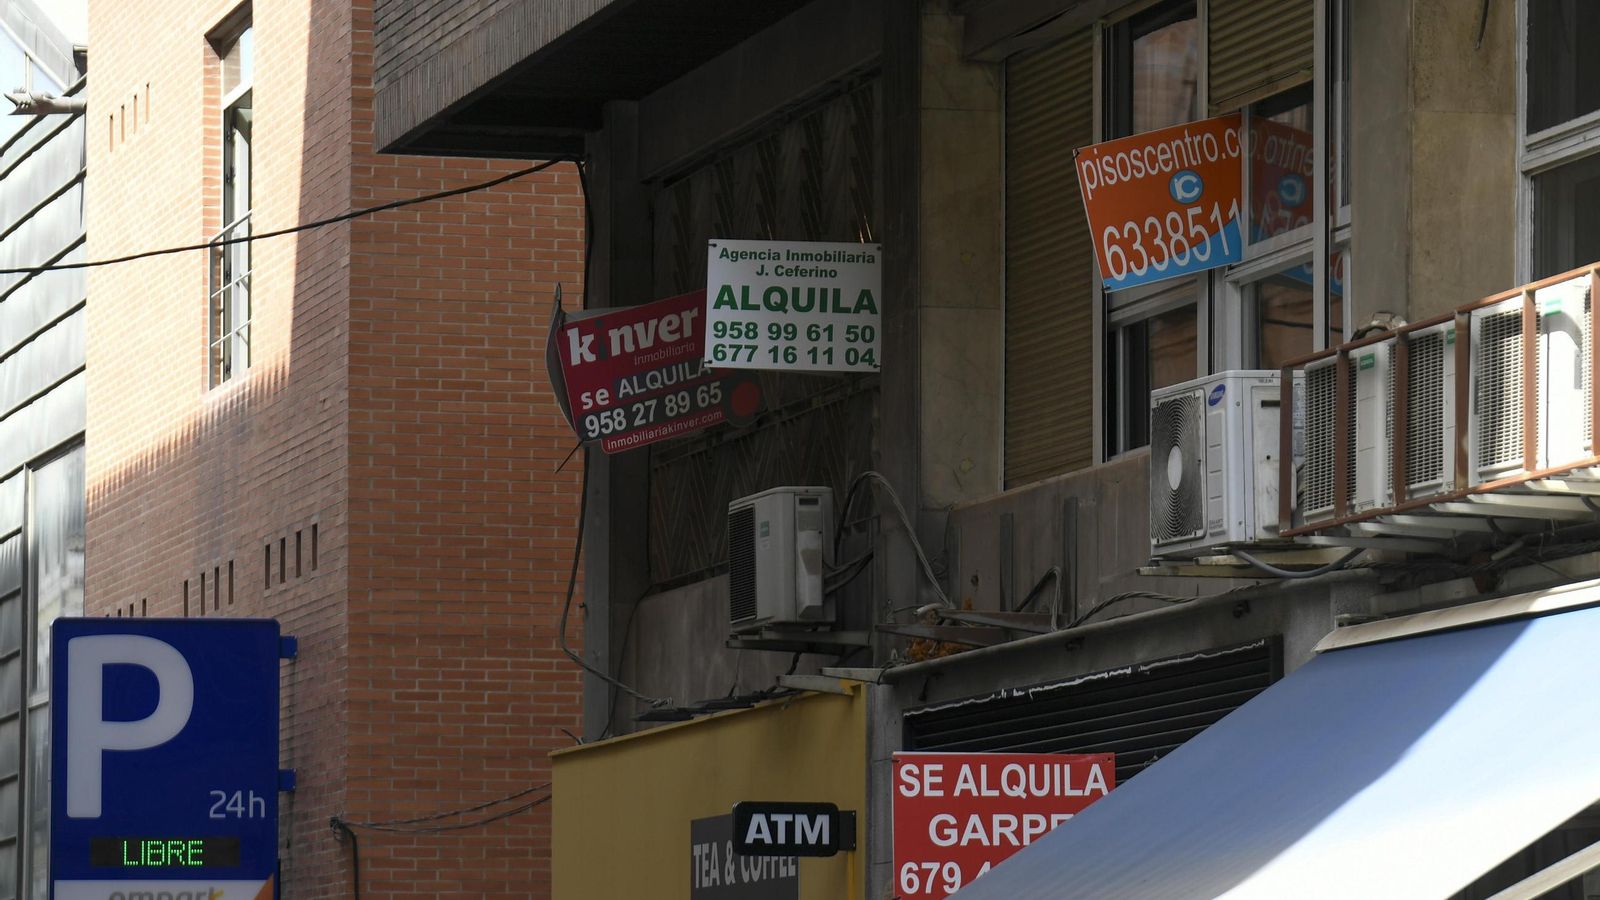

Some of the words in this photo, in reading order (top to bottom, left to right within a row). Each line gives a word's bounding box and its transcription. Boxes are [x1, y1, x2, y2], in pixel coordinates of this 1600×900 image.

[719, 247, 781, 262] Agencia
[786, 249, 875, 264] Inmobiliaria
[756, 264, 769, 276] J.
[774, 264, 838, 279] Ceferino
[713, 284, 878, 315] ALQUILA
[567, 307, 699, 366] kinver
[713, 320, 758, 339] 958
[768, 322, 798, 341] 99
[806, 323, 834, 342] 61
[845, 325, 875, 343] 50
[712, 343, 758, 362] 677
[768, 345, 798, 364] 16
[807, 346, 833, 365] 11
[845, 347, 876, 366] 04
[580, 387, 610, 410] se
[618, 357, 712, 399] ALQUILA
[585, 407, 627, 438] 958
[632, 399, 657, 429] 27
[665, 390, 691, 417] 89
[696, 381, 722, 408] 65
[607, 410, 722, 450] inmobiliariakinver.com
[66, 634, 195, 818] P
[899, 763, 944, 798] SE
[953, 763, 1110, 800] ALQUILA
[209, 790, 266, 818] 24h
[744, 813, 830, 845] ATM
[123, 840, 203, 866] LIBRE
[693, 842, 720, 889] TEA
[724, 839, 736, 886] &
[900, 861, 962, 895] 679
